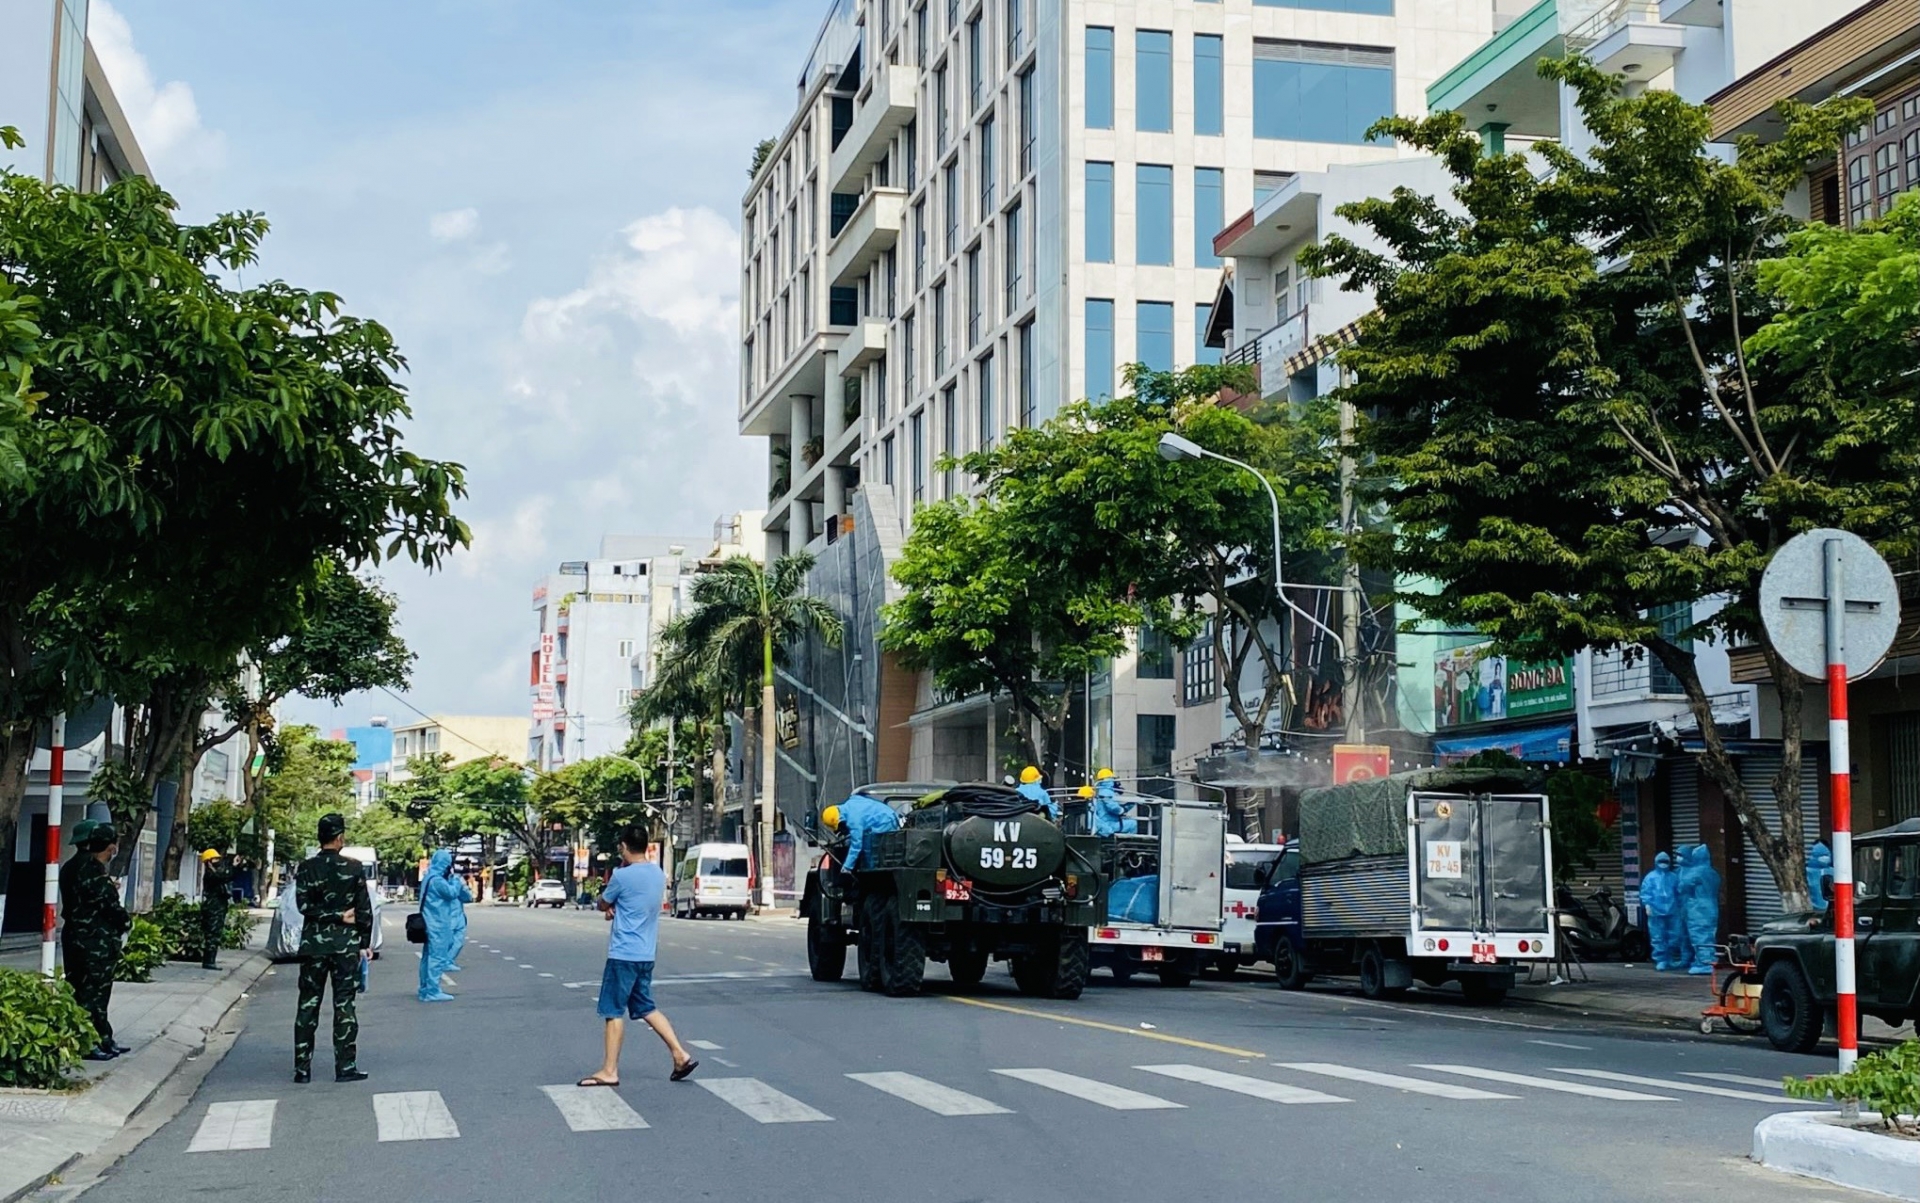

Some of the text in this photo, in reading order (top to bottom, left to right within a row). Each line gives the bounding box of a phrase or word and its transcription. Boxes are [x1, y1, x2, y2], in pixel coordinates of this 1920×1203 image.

[542, 634, 554, 683] HOTEL
[993, 821, 1021, 842] KV
[980, 847, 1037, 869] 59-25
[1437, 845, 1451, 858] KV
[1429, 860, 1459, 873] 78-45
